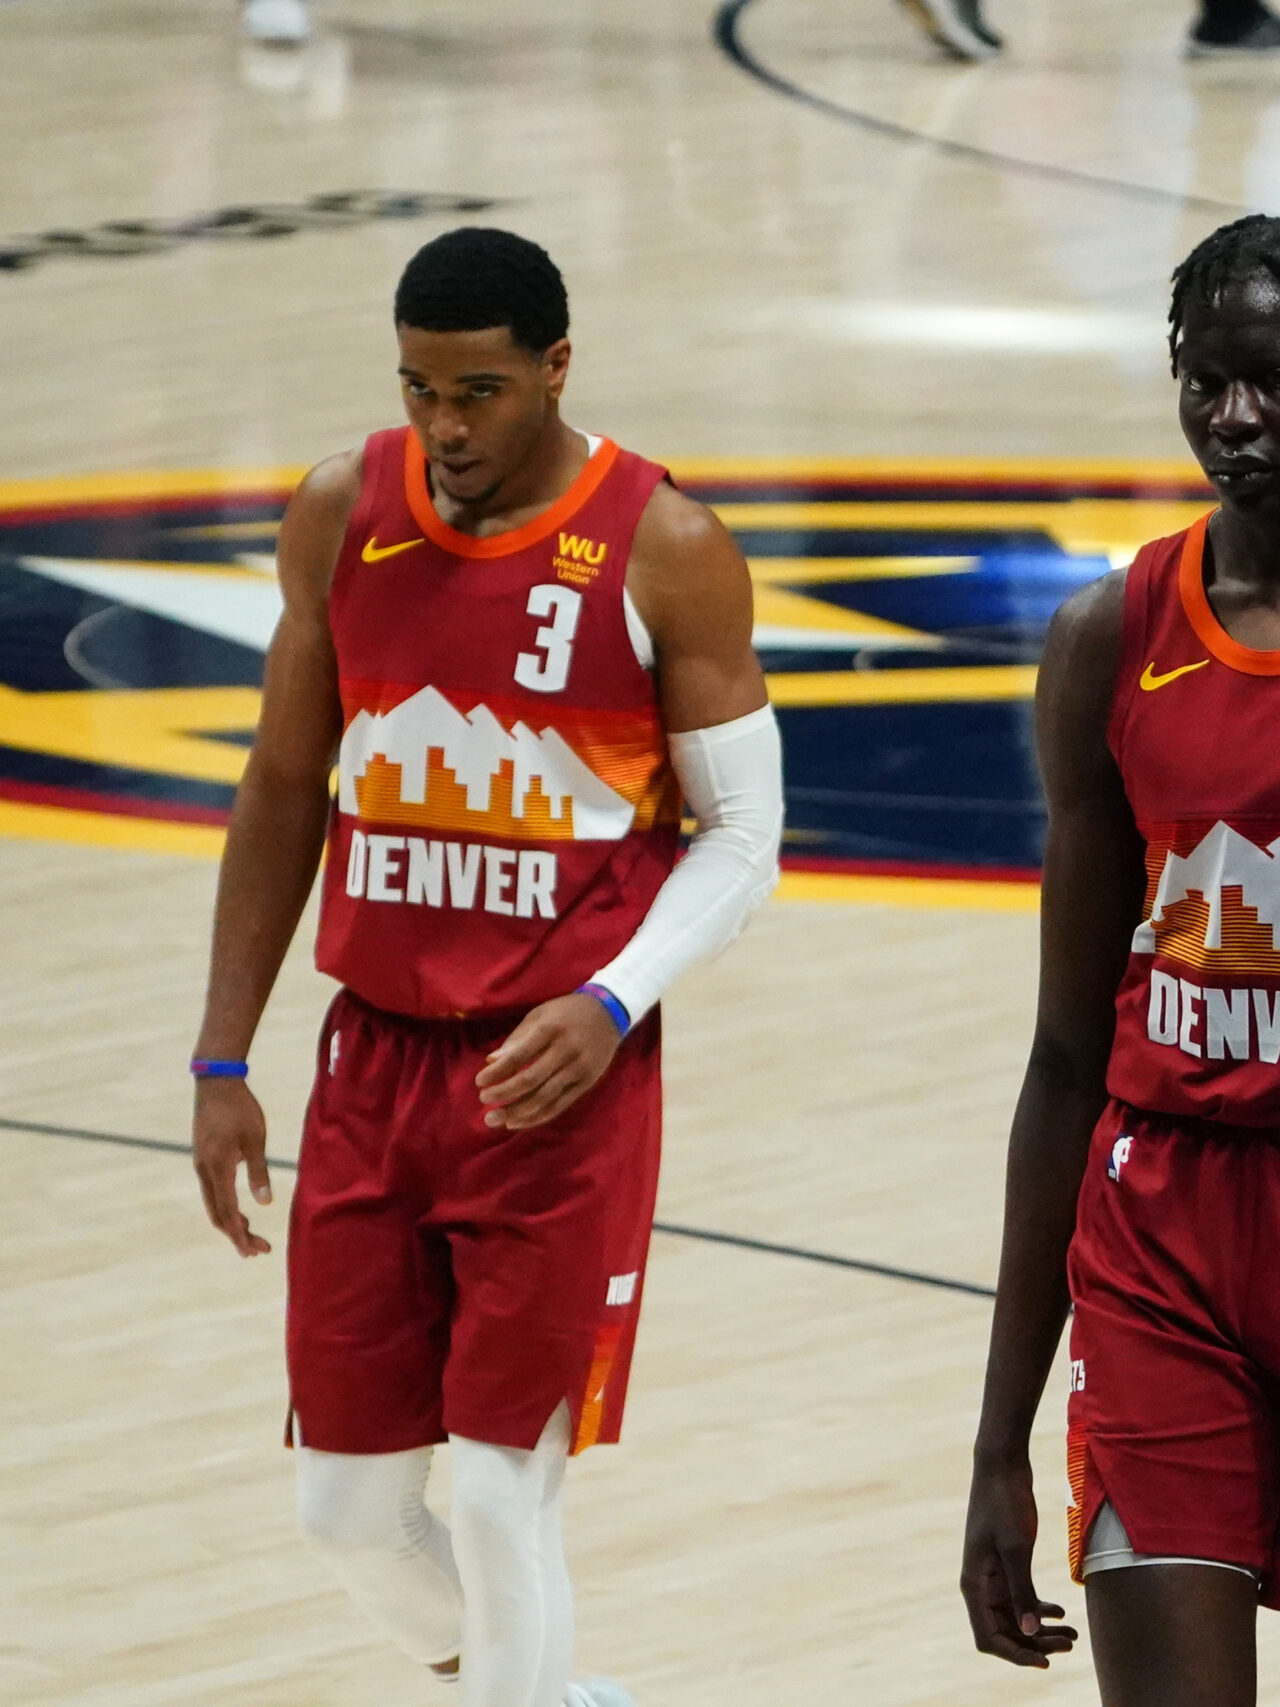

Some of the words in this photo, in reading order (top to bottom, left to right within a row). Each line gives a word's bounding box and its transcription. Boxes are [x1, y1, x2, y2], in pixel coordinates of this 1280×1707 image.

[558, 532, 608, 564] WU
[552, 556, 599, 576] Western
[557, 569, 590, 584] Union
[513, 583, 582, 693] 3
[346, 829, 557, 919] DENVER
